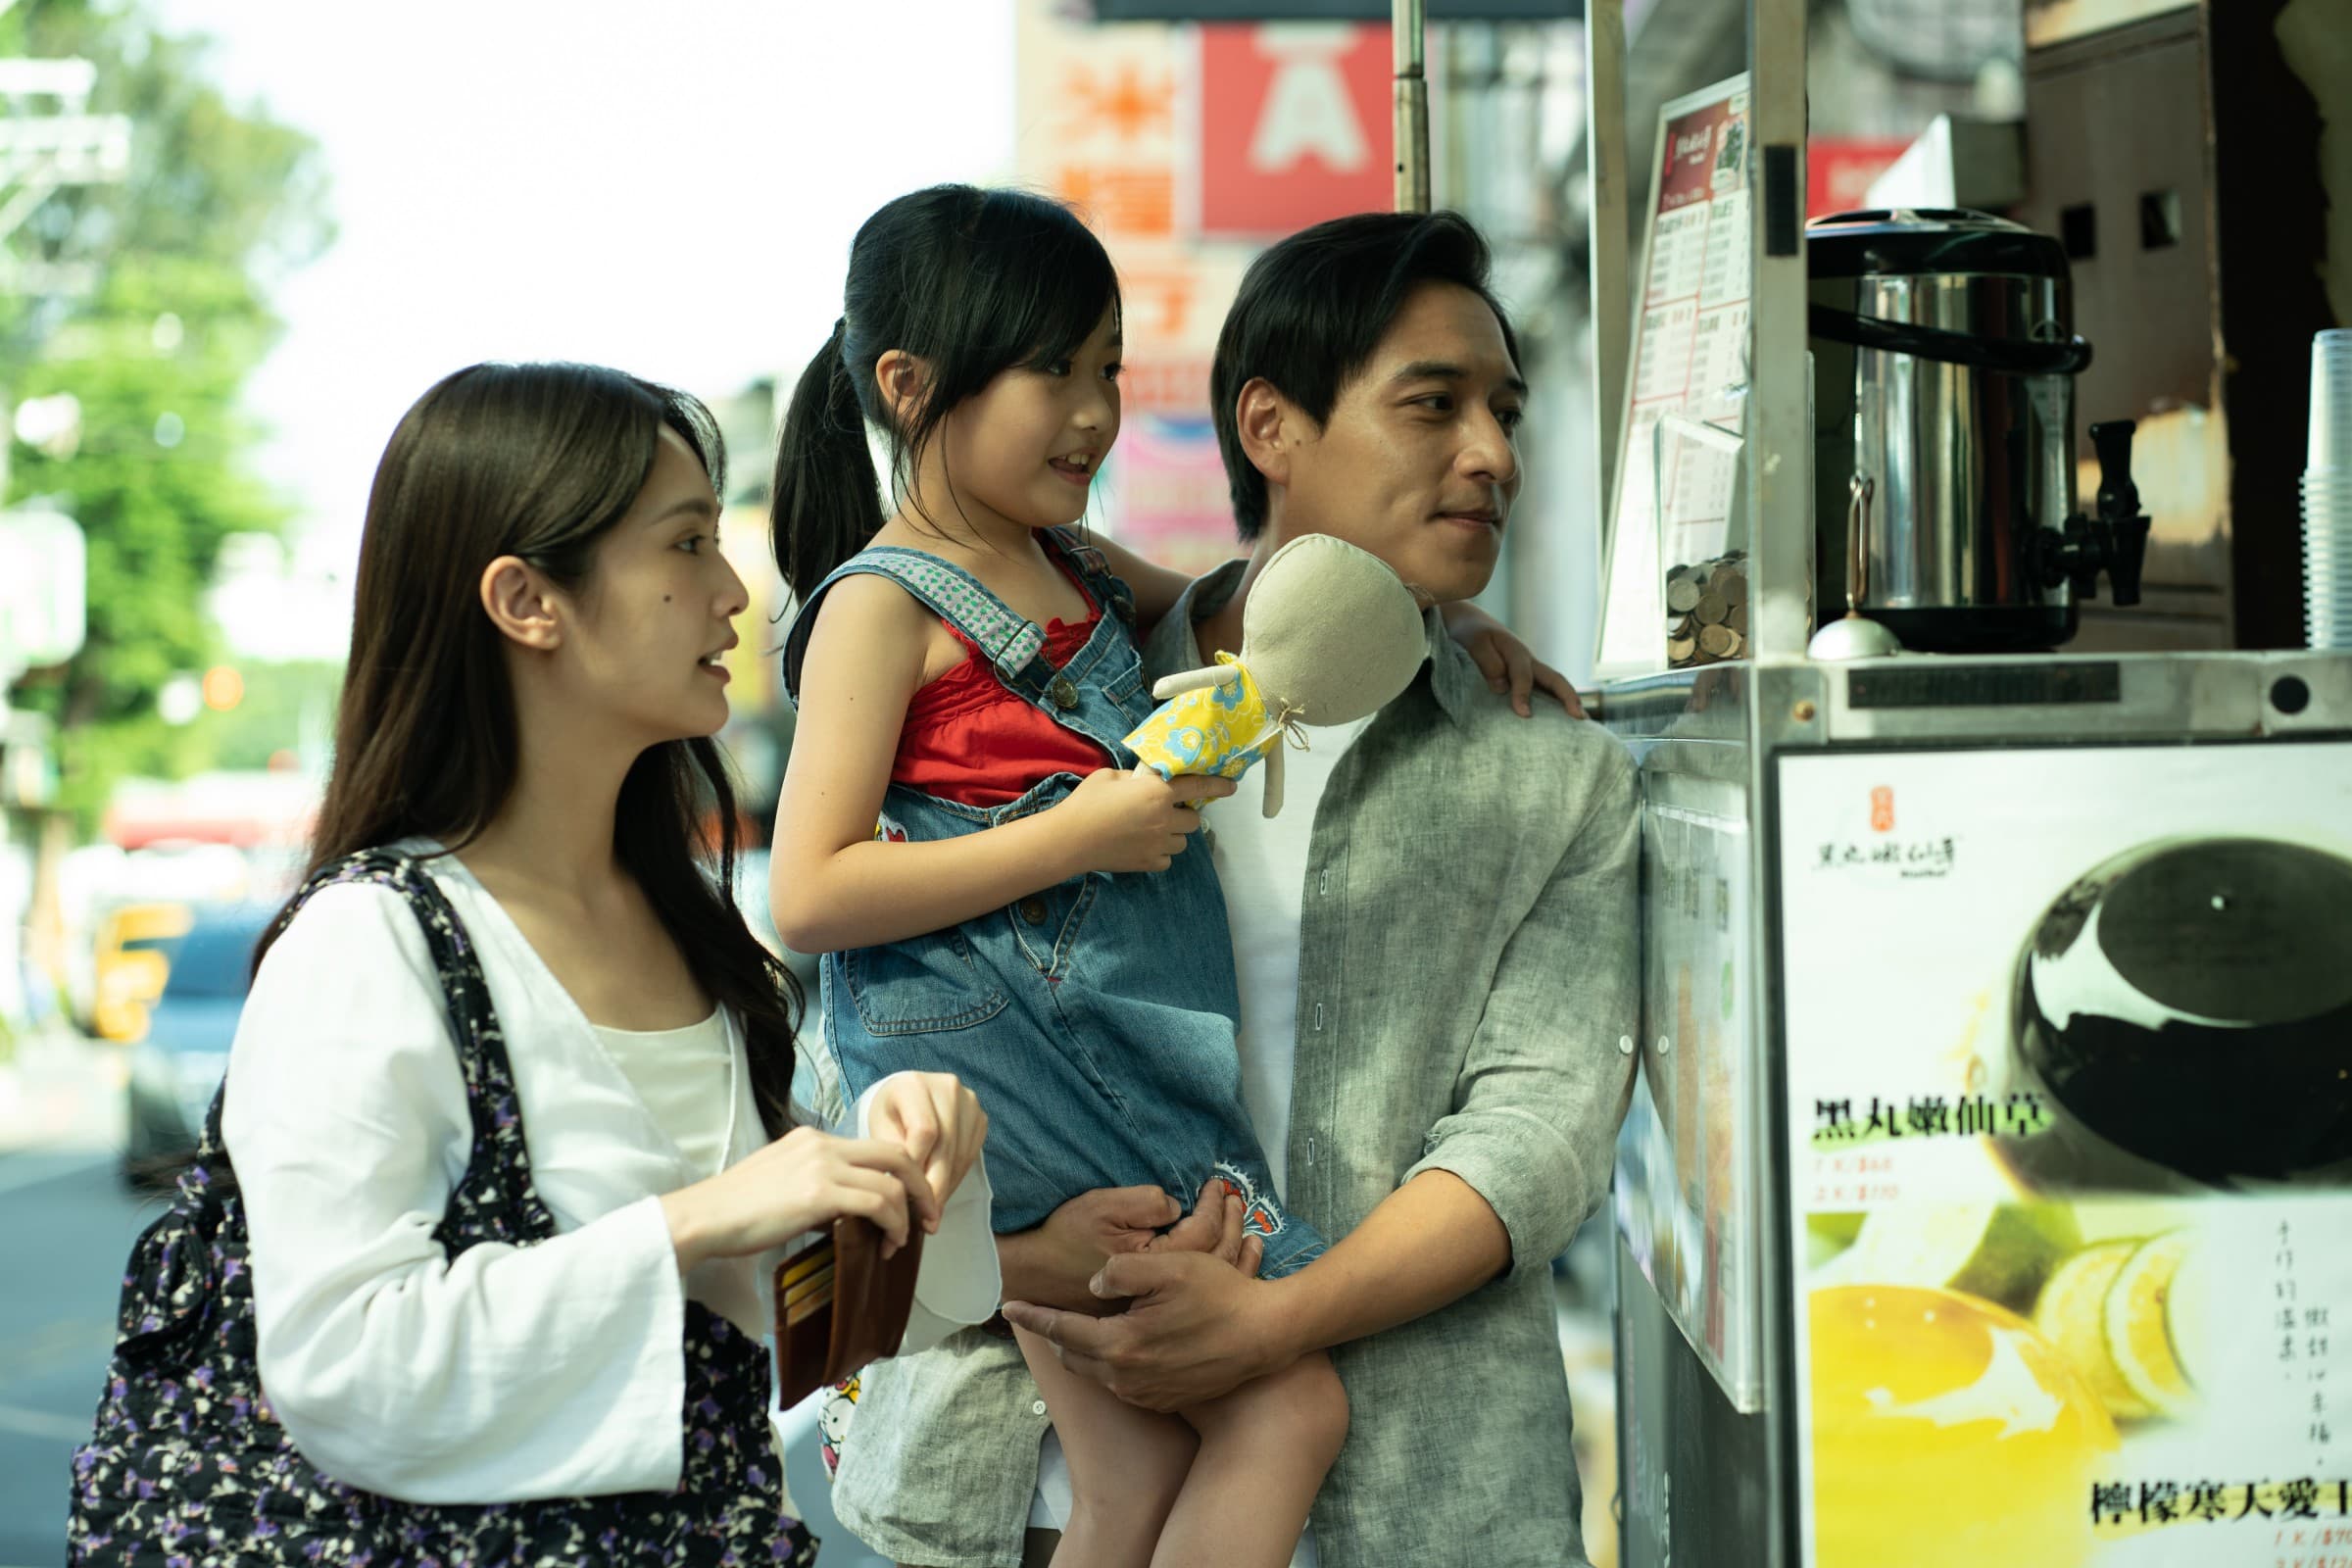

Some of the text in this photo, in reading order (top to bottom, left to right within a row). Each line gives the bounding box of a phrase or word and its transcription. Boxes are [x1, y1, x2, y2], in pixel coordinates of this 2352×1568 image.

[1813, 1092, 2046, 1140] 黑丸嫩仙草
